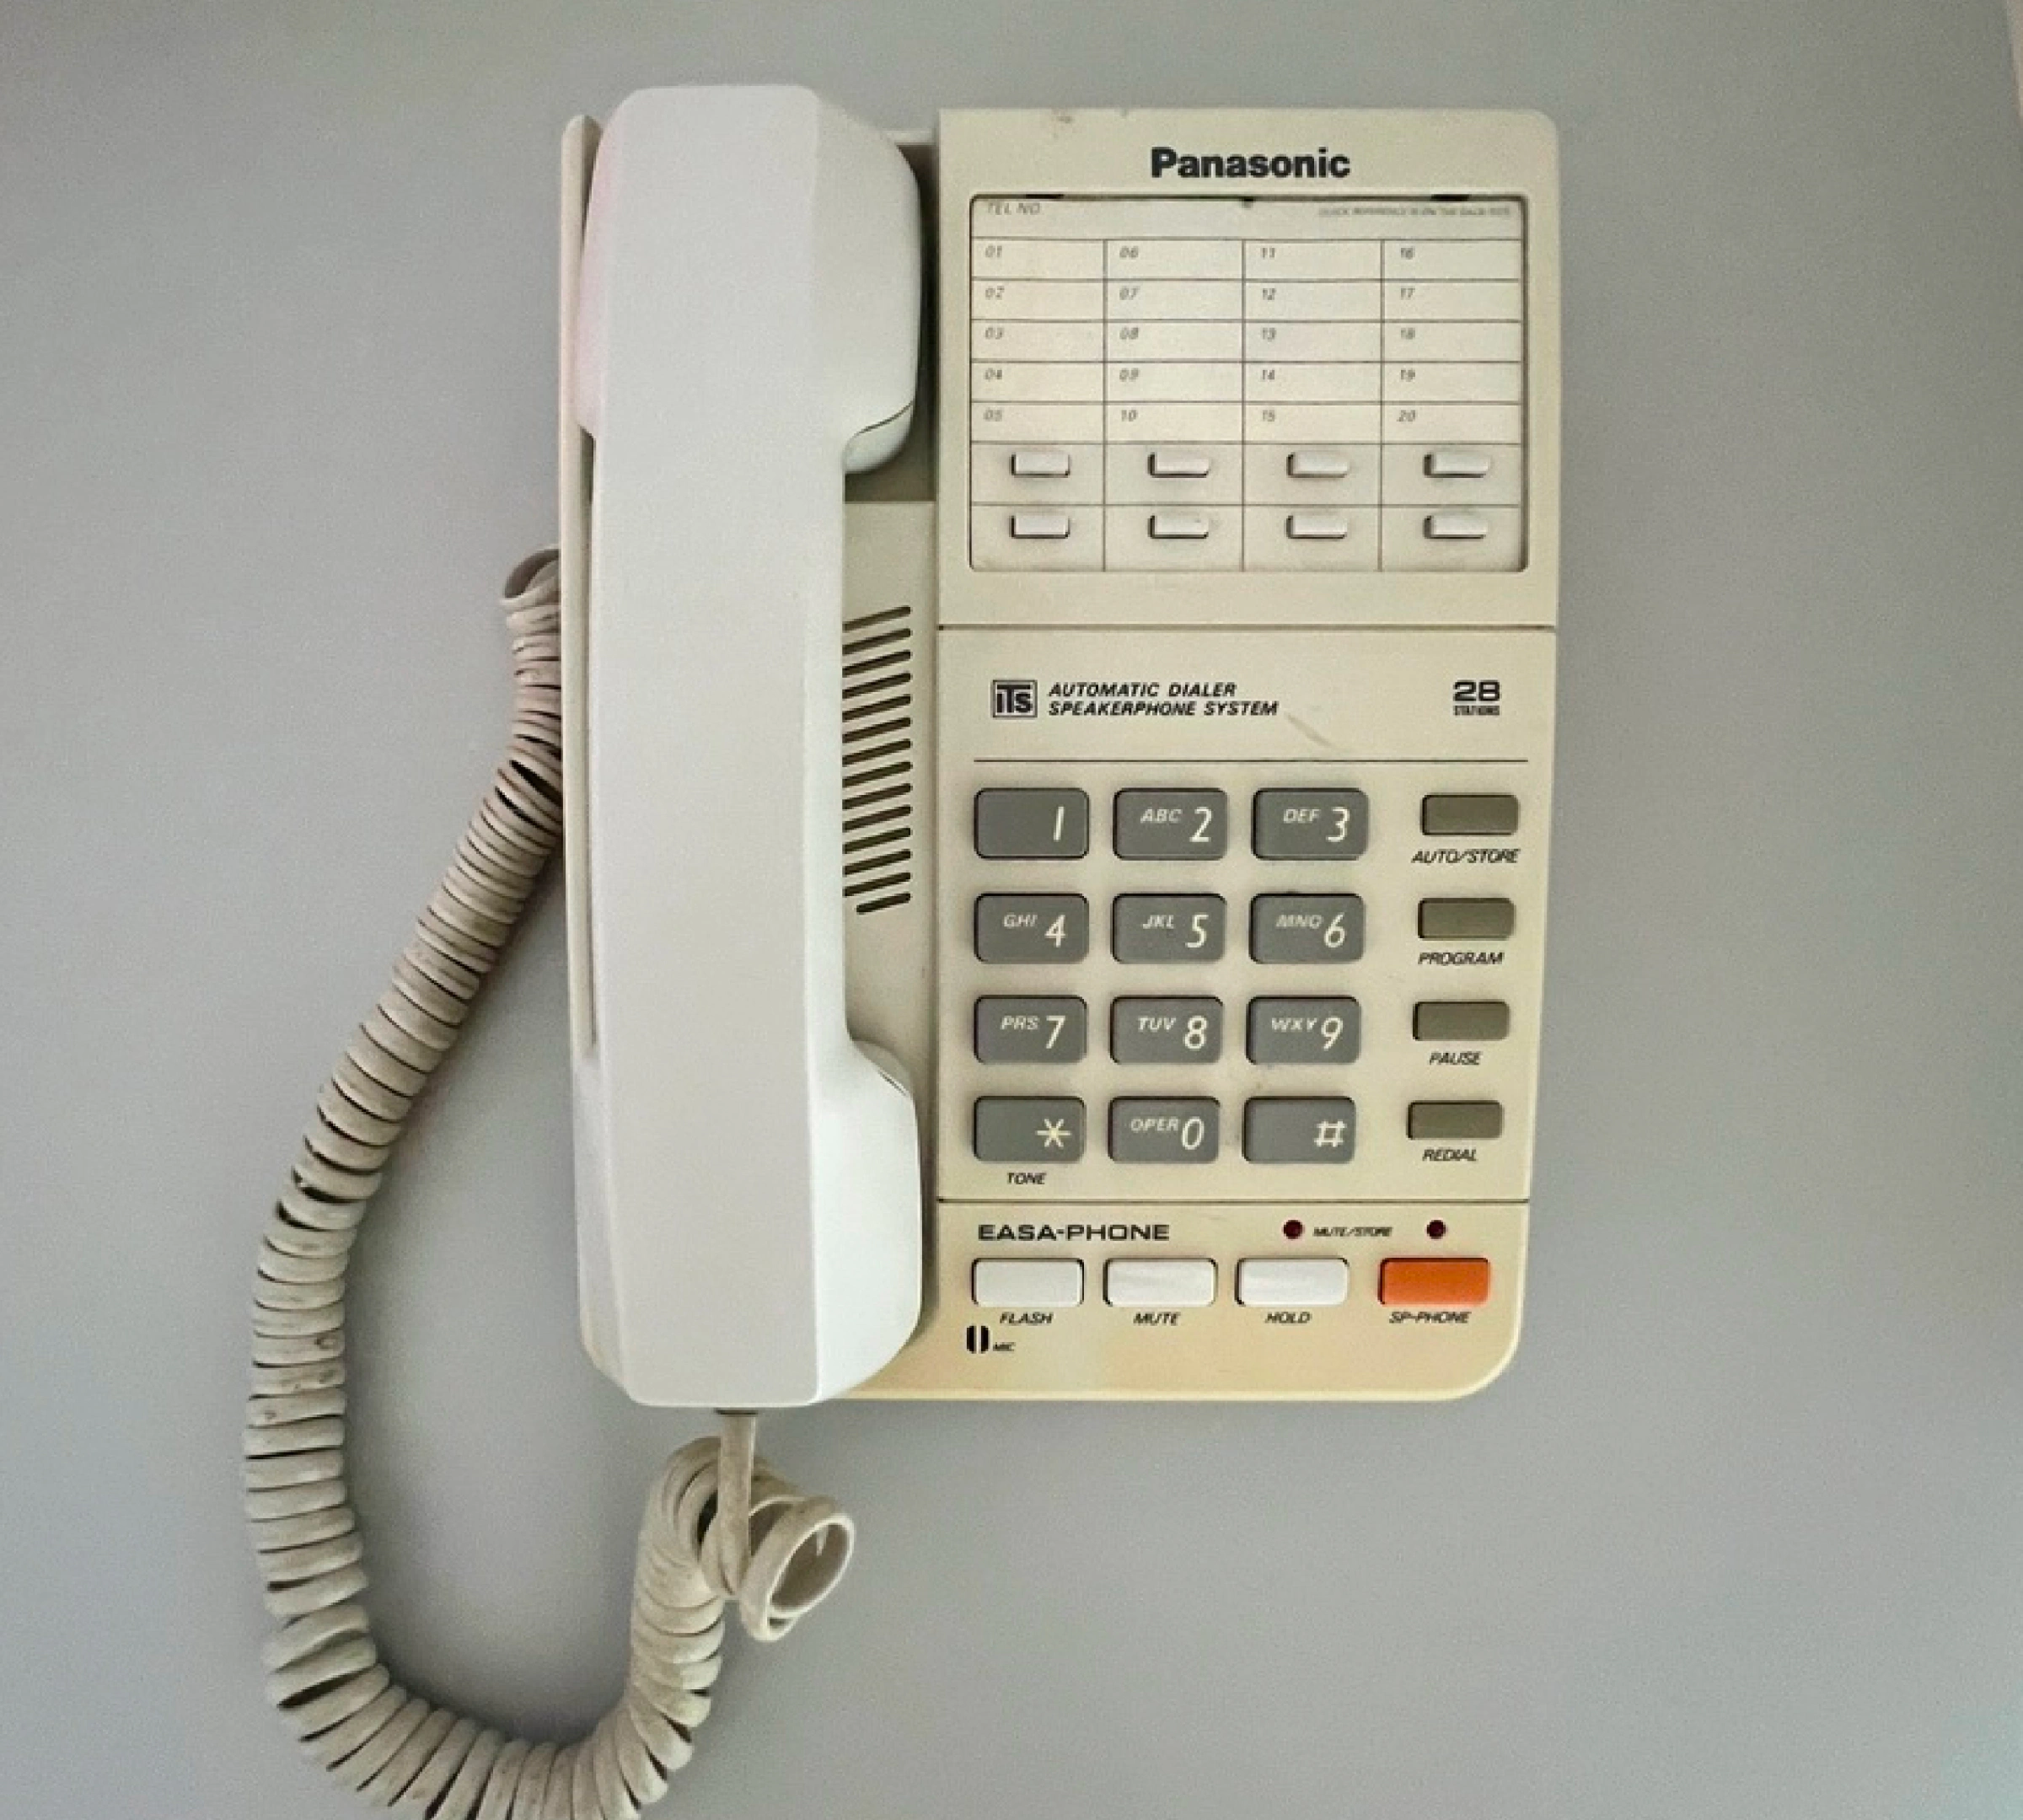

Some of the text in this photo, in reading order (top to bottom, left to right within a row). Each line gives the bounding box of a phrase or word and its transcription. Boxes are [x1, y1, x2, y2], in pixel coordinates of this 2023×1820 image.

[1151, 146, 1350, 179] Panasonic
[986, 201, 1012, 216] TEL
[985, 244, 1003, 259] 01
[1119, 245, 1140, 260] 06
[1260, 247, 1276, 260] 11
[1400, 247, 1416, 260] 16
[985, 285, 1006, 301] 02
[1119, 285, 1140, 301] 07
[1262, 287, 1277, 301] 12
[1400, 287, 1416, 301] 17
[985, 326, 1005, 341] 03
[1119, 326, 1140, 341] 08
[1262, 327, 1277, 342] 13
[1400, 327, 1416, 341] 18
[985, 368, 1003, 381] 04
[1119, 367, 1141, 383] 09
[1261, 368, 1276, 382] 14
[1400, 368, 1416, 383] 19
[984, 407, 1004, 423] 05
[1119, 409, 1139, 423] 10
[1262, 409, 1276, 422] 15
[1398, 409, 1417, 423] 20
[1048, 681, 1237, 698] AUTOMATIC DIALER
[1452, 679, 1500, 702] 28
[1048, 700, 1280, 717] SPEAKERPHONE SYSTEM
[1053, 806, 1065, 841] 1
[1140, 806, 1212, 843] ABC 2
[1283, 806, 1350, 843] DEF 3
[1410, 848, 1521, 864] AUTO/STORE
[1003, 914, 1066, 948] GHI 4
[1142, 914, 1210, 948] JKL 5
[1275, 914, 1345, 948] MNO 6
[1417, 952, 1505, 967] PROGRAM
[1001, 1015, 1066, 1050] PRS 7
[1137, 1015, 1208, 1050] TUV 8
[1271, 1017, 1344, 1051] WXY 9
[1429, 1050, 1481, 1066] PAUSE
[1130, 1116, 1205, 1151] OPER 0
[1313, 1119, 1346, 1148] #
[1421, 1148, 1477, 1162] REDIAL
[1006, 1172, 1047, 1185] TONE
[978, 1224, 1170, 1242] EASA-PHONE
[1313, 1226, 1393, 1237] MUTE/STORE
[999, 1311, 1054, 1326] FLASH
[1133, 1311, 1180, 1326] MUTE
[1264, 1311, 1311, 1324] HOLD
[1388, 1311, 1473, 1324] SP-PHONE
